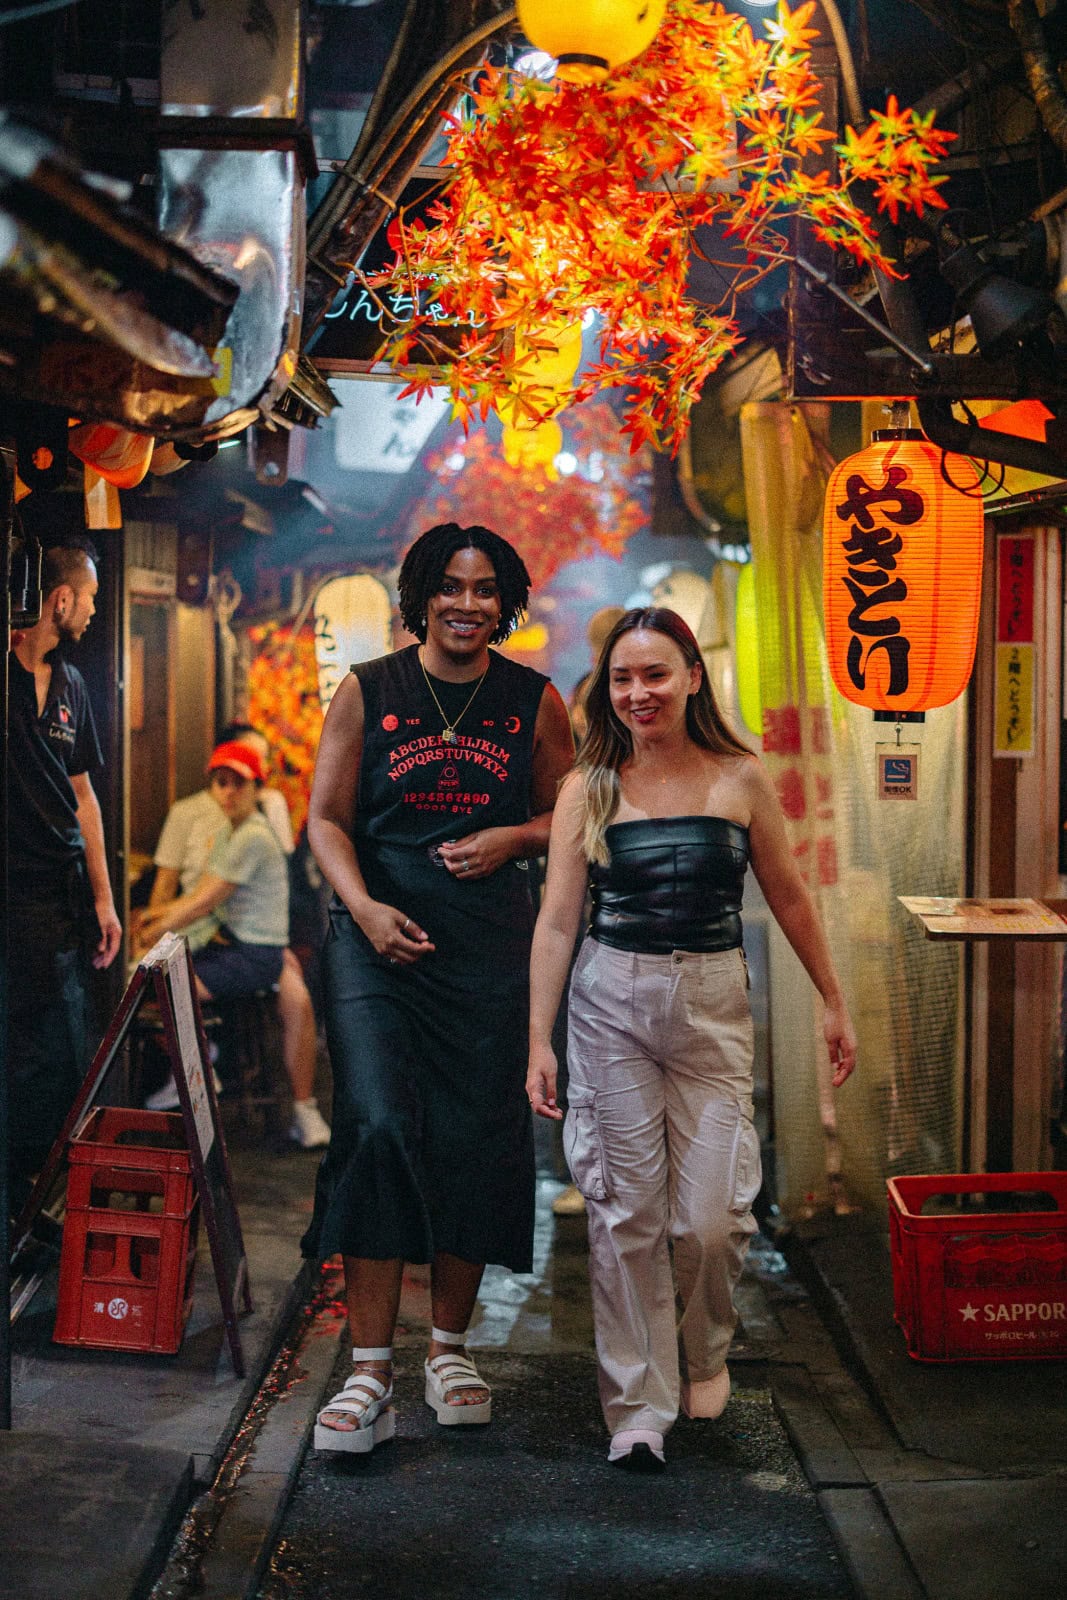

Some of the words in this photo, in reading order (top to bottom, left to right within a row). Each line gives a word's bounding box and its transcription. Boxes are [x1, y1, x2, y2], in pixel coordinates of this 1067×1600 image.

[836, 466, 924, 696] やきとり
[405, 718, 421, 726] YES
[387, 748, 510, 782] NOPQRSTUVWXYZ
[404, 793, 490, 805] 1234567890
[416, 803, 447, 812] GOOD
[451, 805, 473, 815] BYE
